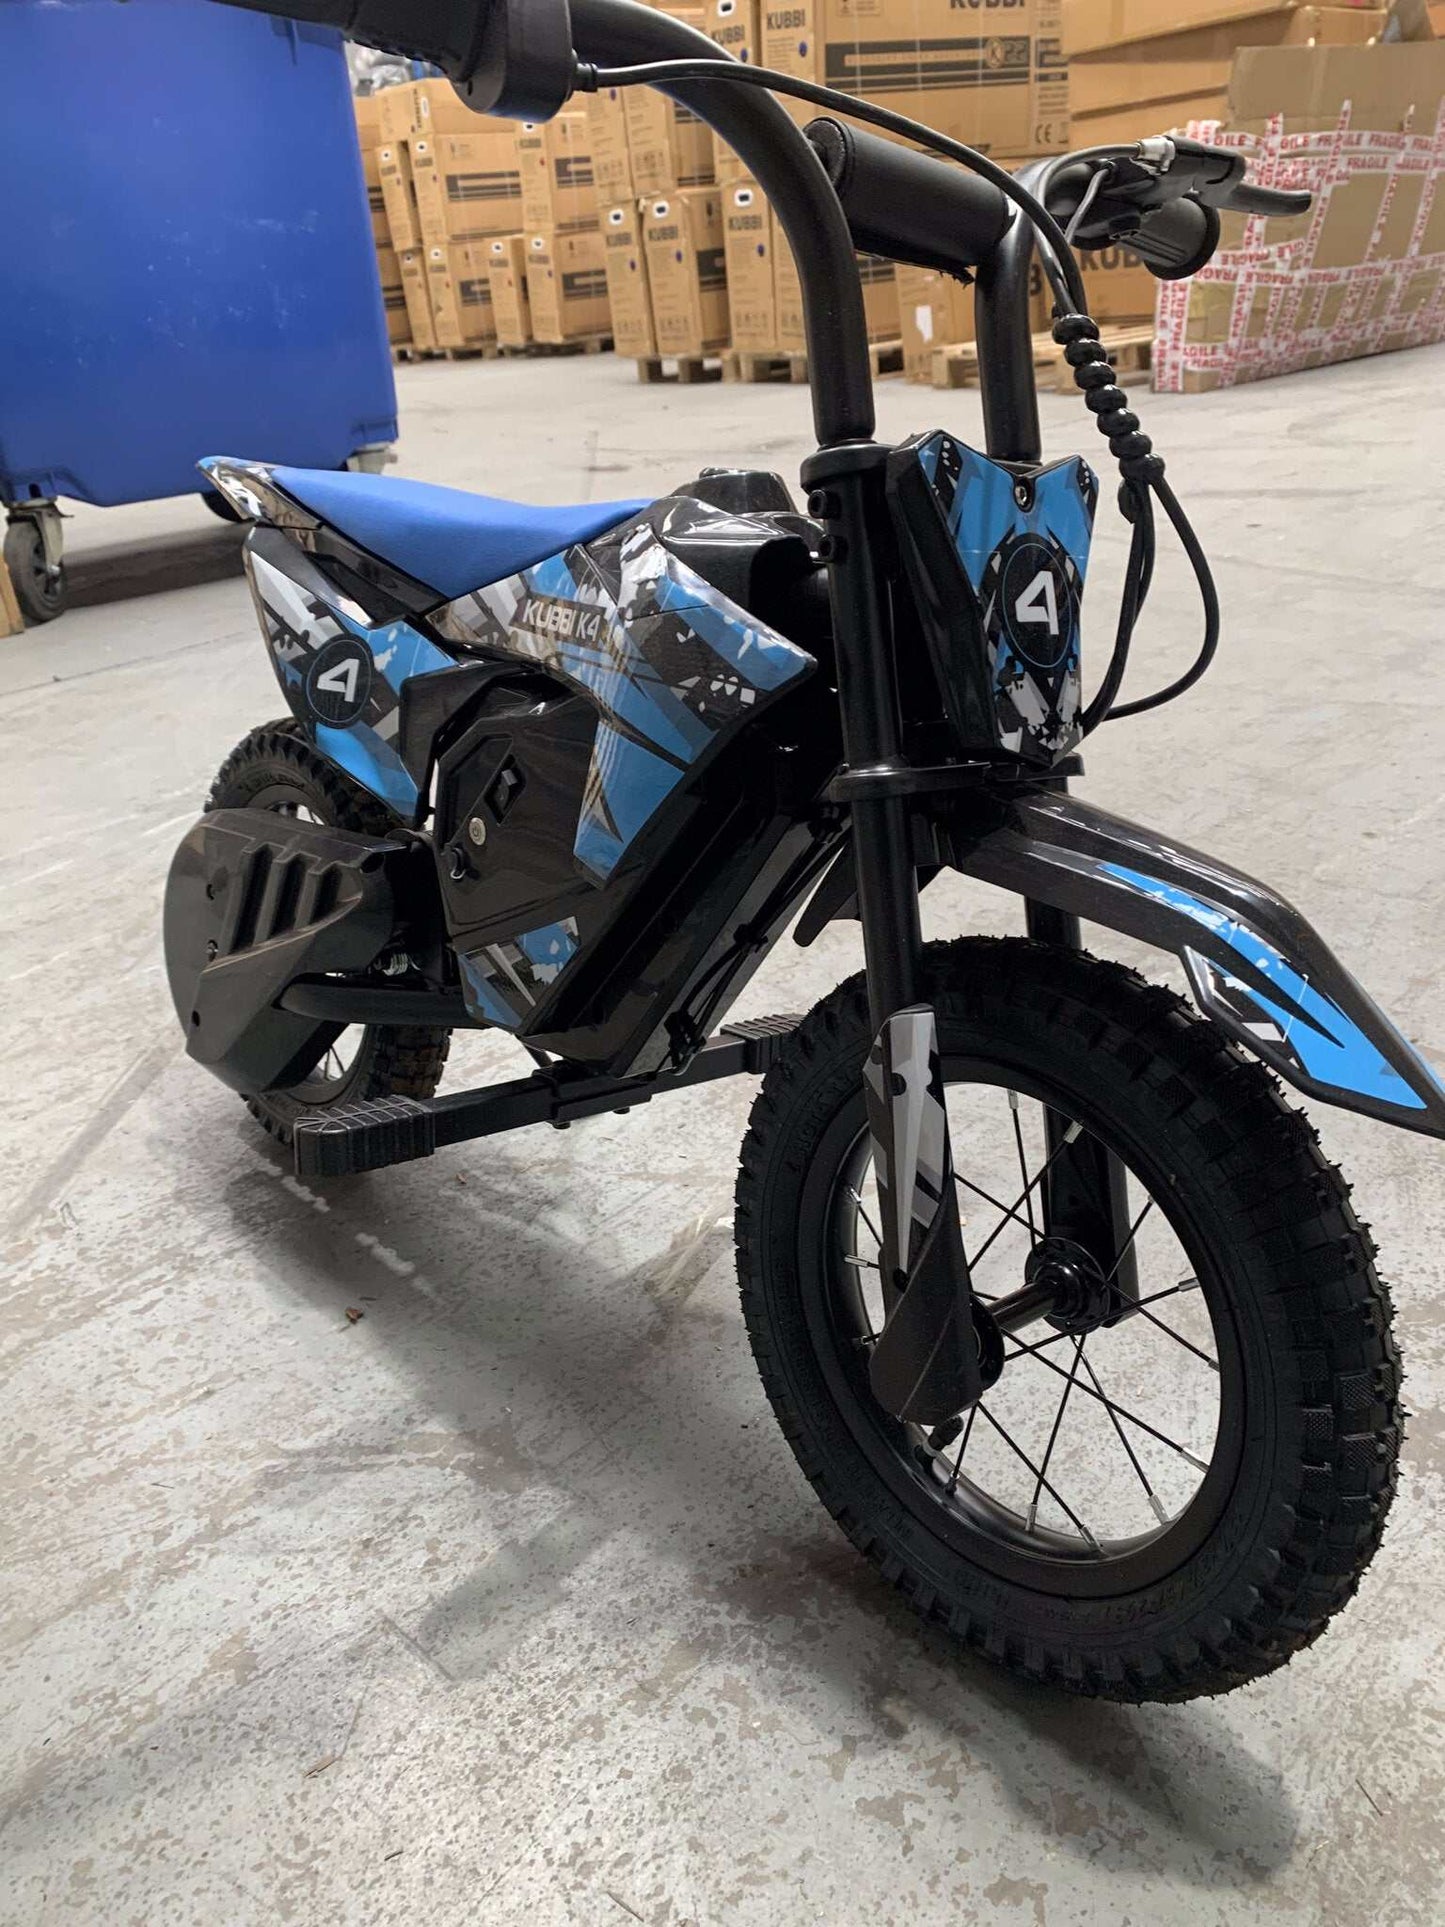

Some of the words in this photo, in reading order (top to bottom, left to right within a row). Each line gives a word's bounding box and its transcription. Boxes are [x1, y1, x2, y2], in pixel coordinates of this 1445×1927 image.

[766, 9, 806, 30] KUBBI
[522, 599, 577, 636] KUBBI
[575, 611, 601, 642] K4
[1015, 570, 1060, 636] 4
[317, 658, 360, 702] 4
